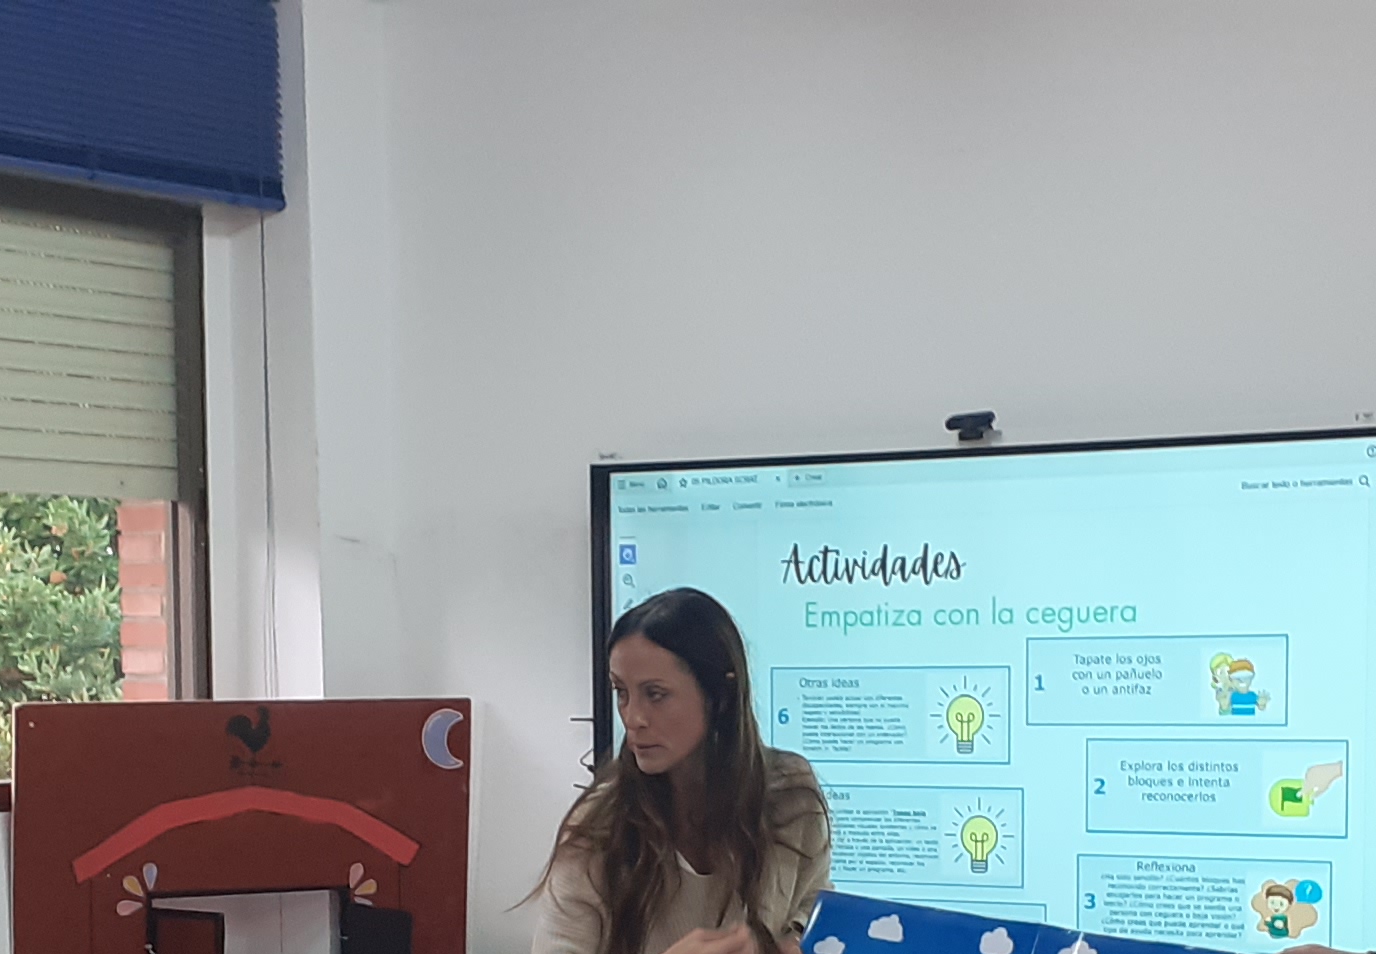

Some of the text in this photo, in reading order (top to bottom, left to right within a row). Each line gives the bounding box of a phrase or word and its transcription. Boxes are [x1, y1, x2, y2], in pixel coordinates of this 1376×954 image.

[781, 542, 967, 587] Actividades
[805, 597, 1137, 635] Empatiza con la ceguera
[1116, 653, 1132, 665] los
[1137, 654, 1161, 667] ojos
[1072, 668, 1162, 682] con un pañuelo
[799, 678, 859, 688] Otras ideas
[1034, 675, 1045, 691] 1
[1082, 684, 1151, 695] o un antifaz
[778, 708, 789, 724] 6
[1120, 760, 1239, 775] Explora los distintos
[1094, 778, 1106, 795] 2
[1128, 775, 1230, 788] bloques e intenta
[827, 789, 850, 800] deas
[1142, 791, 1216, 802] reconocerlos
[1137, 861, 1196, 873] Reflexiona
[1084, 893, 1096, 909] 3
